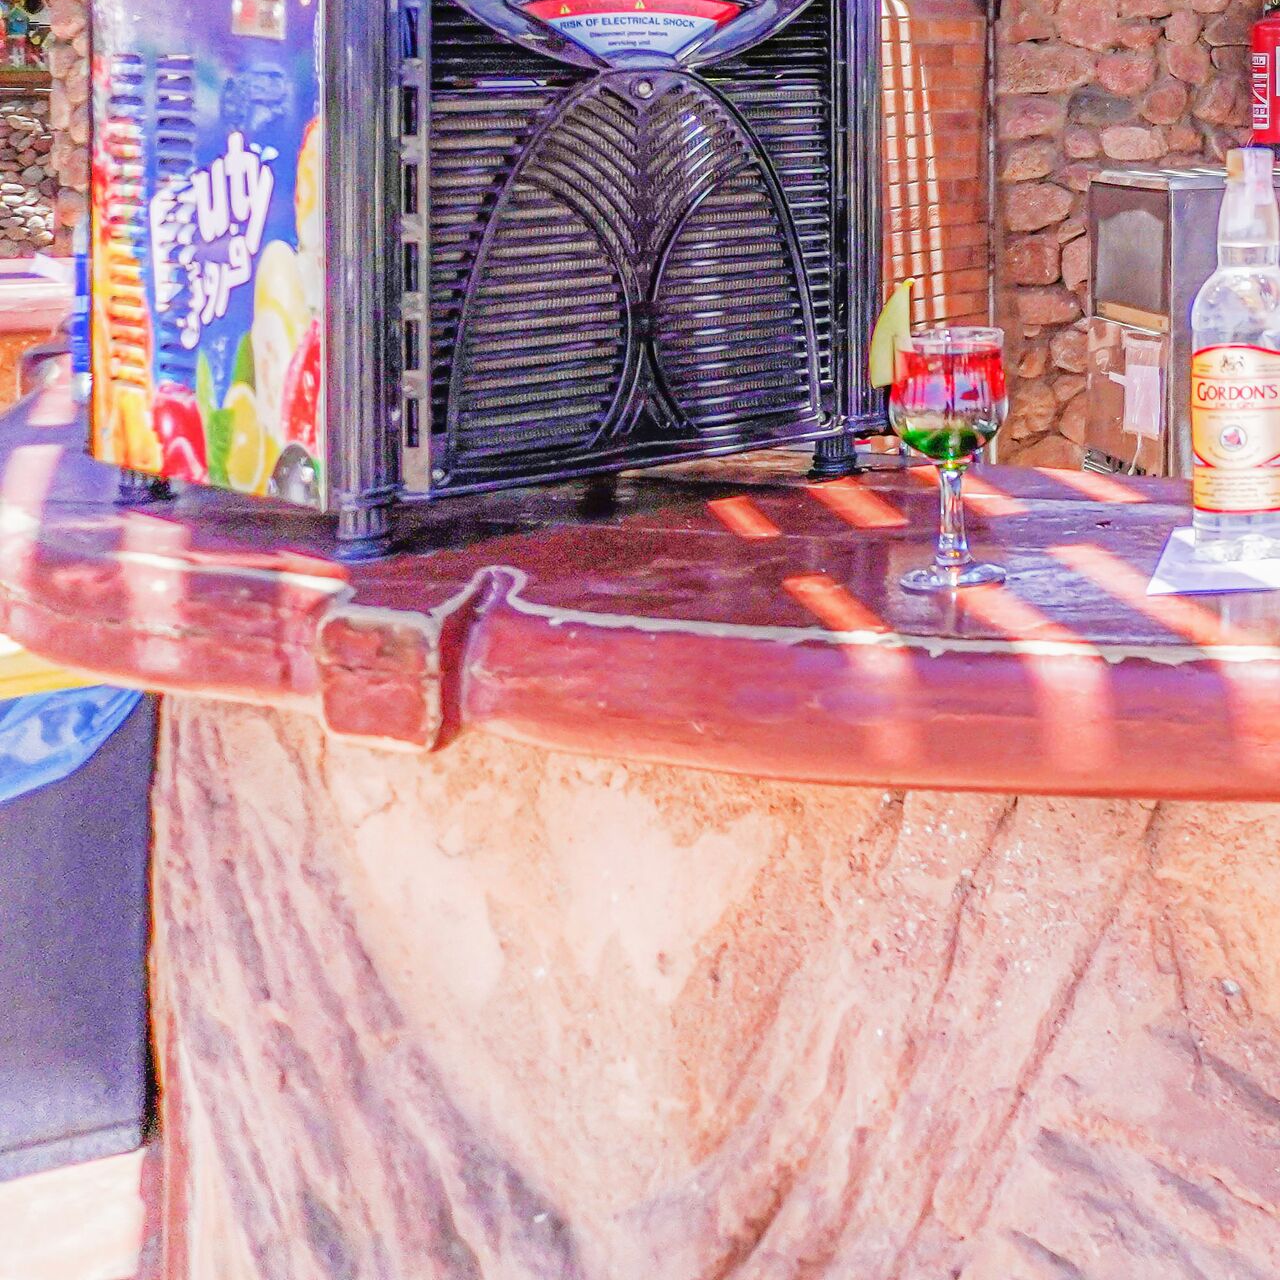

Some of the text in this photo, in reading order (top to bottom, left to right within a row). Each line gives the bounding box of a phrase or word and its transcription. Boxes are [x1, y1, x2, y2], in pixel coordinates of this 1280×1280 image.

[560, 16, 695, 30] RISK OF ELECTRICAL SHOCK
[1197, 382, 1279, 401] GORDON'S
